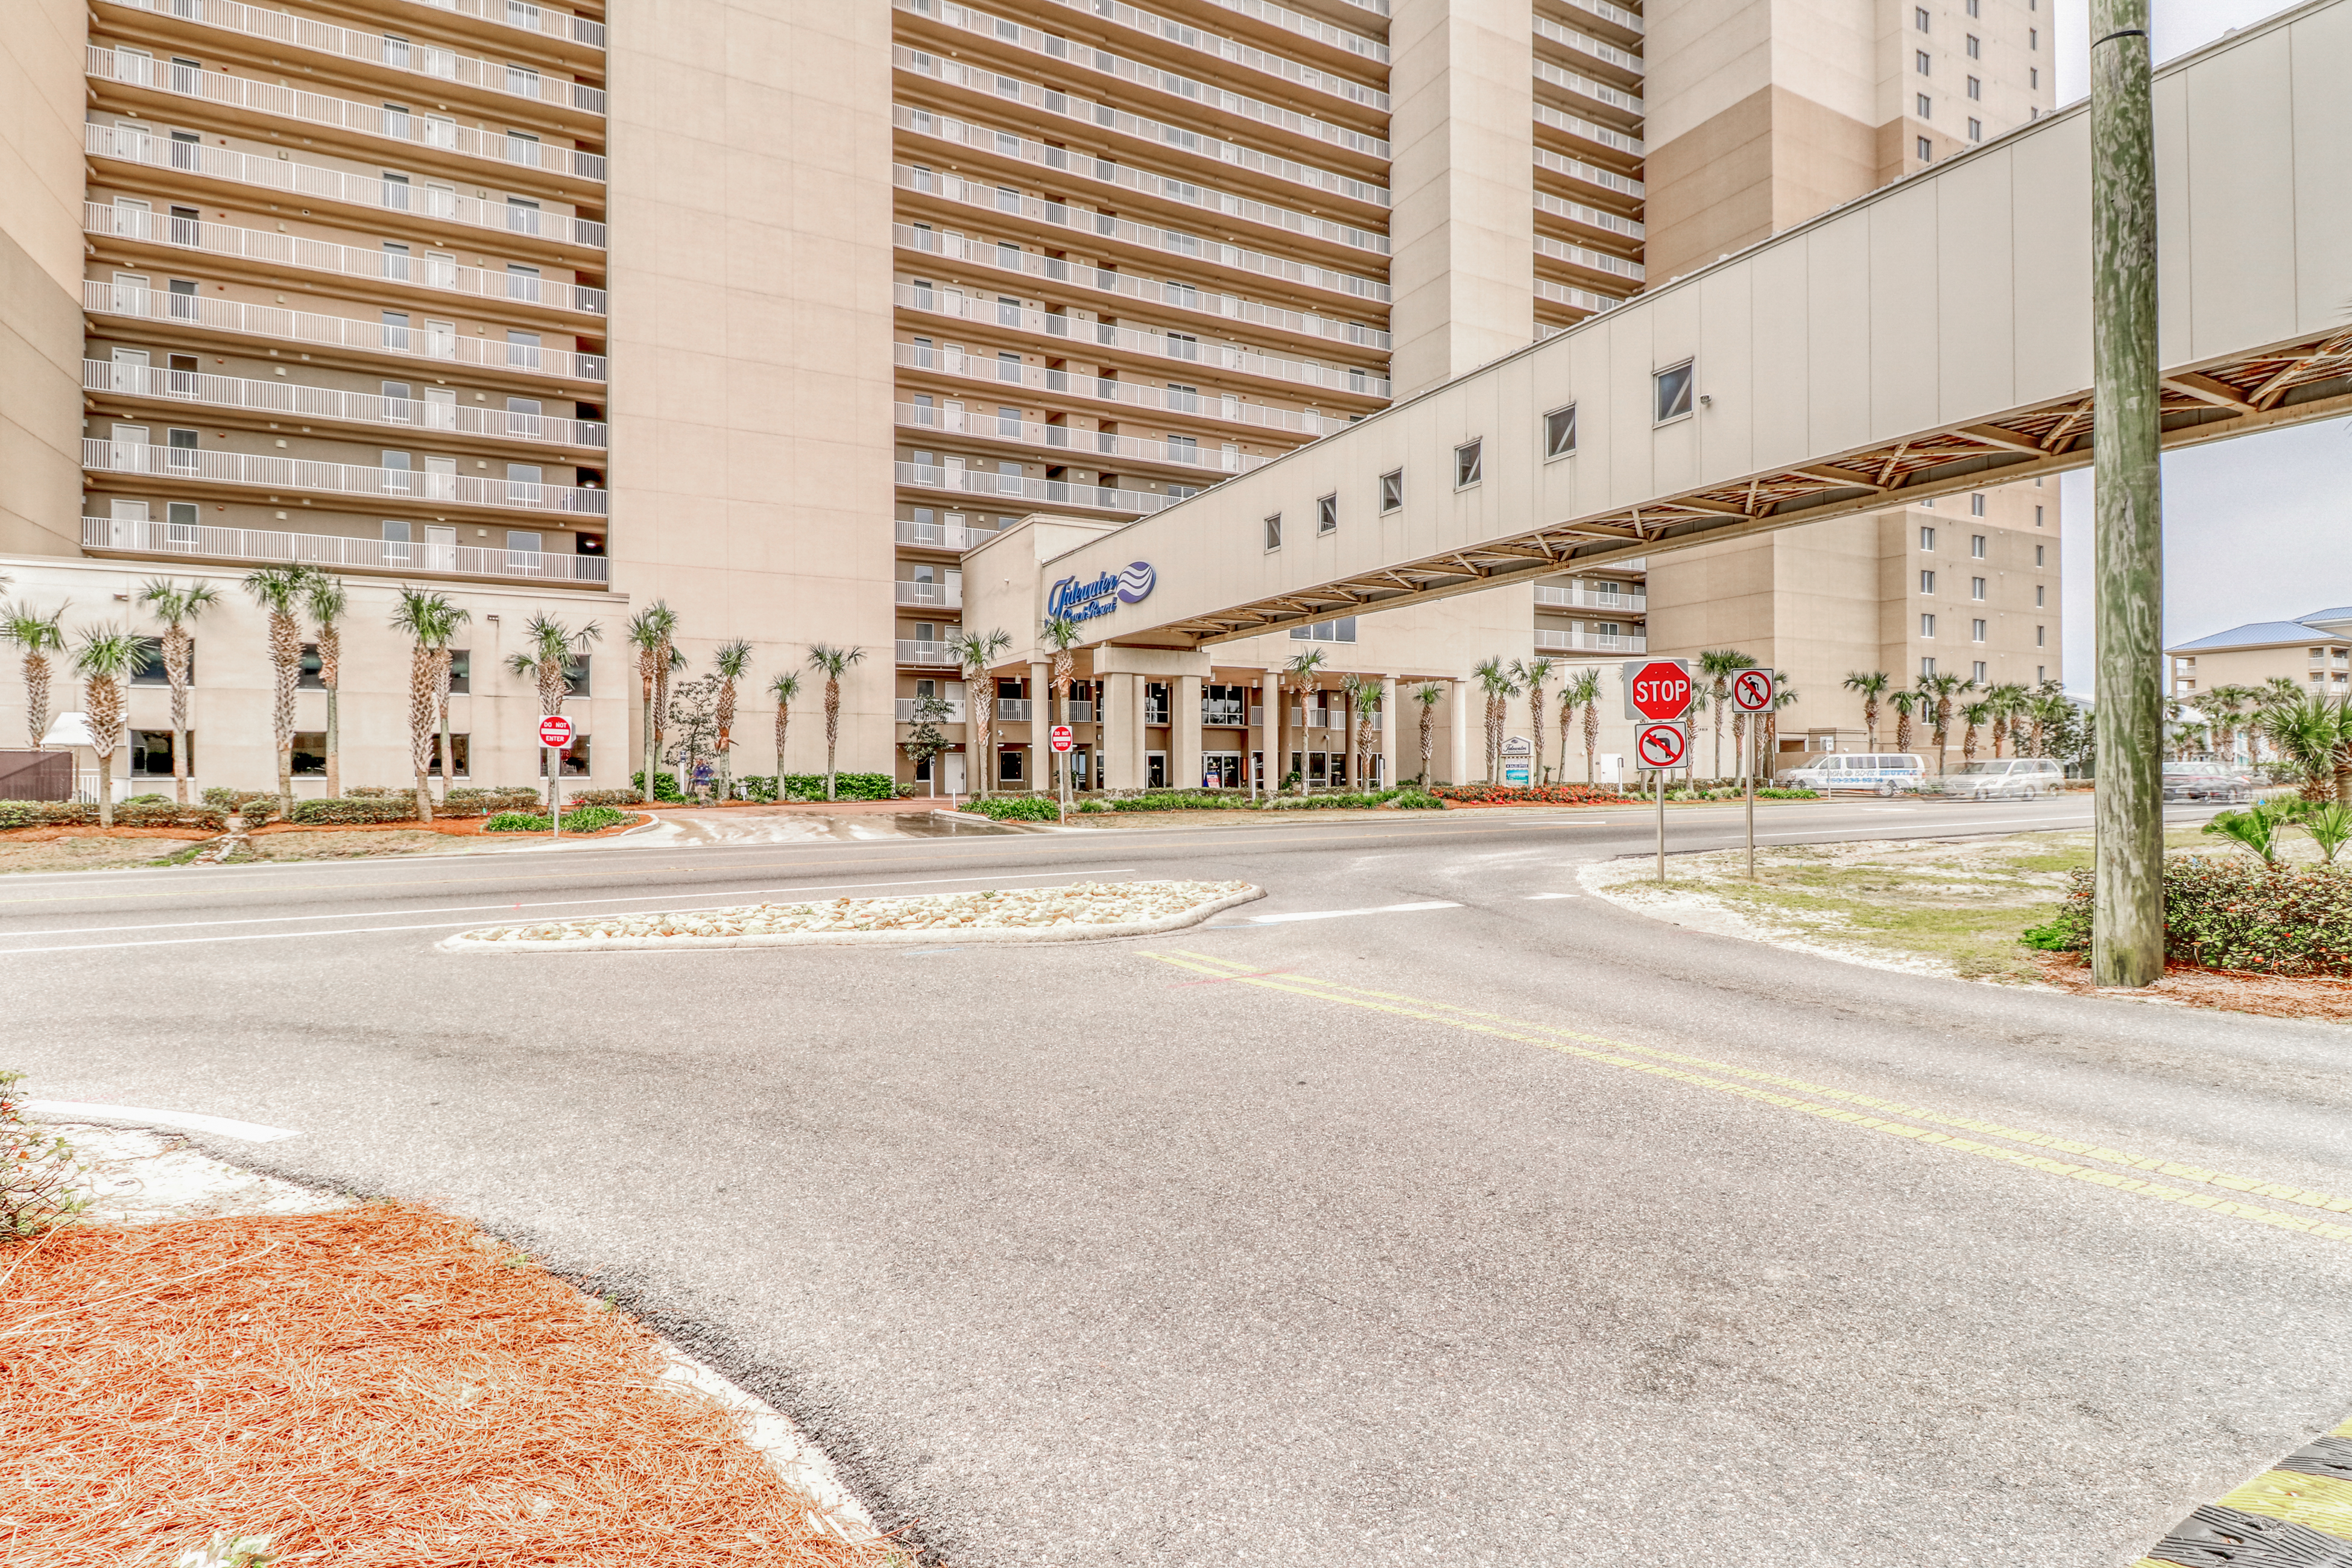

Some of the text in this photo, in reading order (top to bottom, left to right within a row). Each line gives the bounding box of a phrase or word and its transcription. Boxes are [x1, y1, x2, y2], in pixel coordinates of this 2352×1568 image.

[1046, 571, 1119, 621] Tidewater
[1086, 596, 1118, 619] Resort
[1636, 680, 1688, 703] STOP
